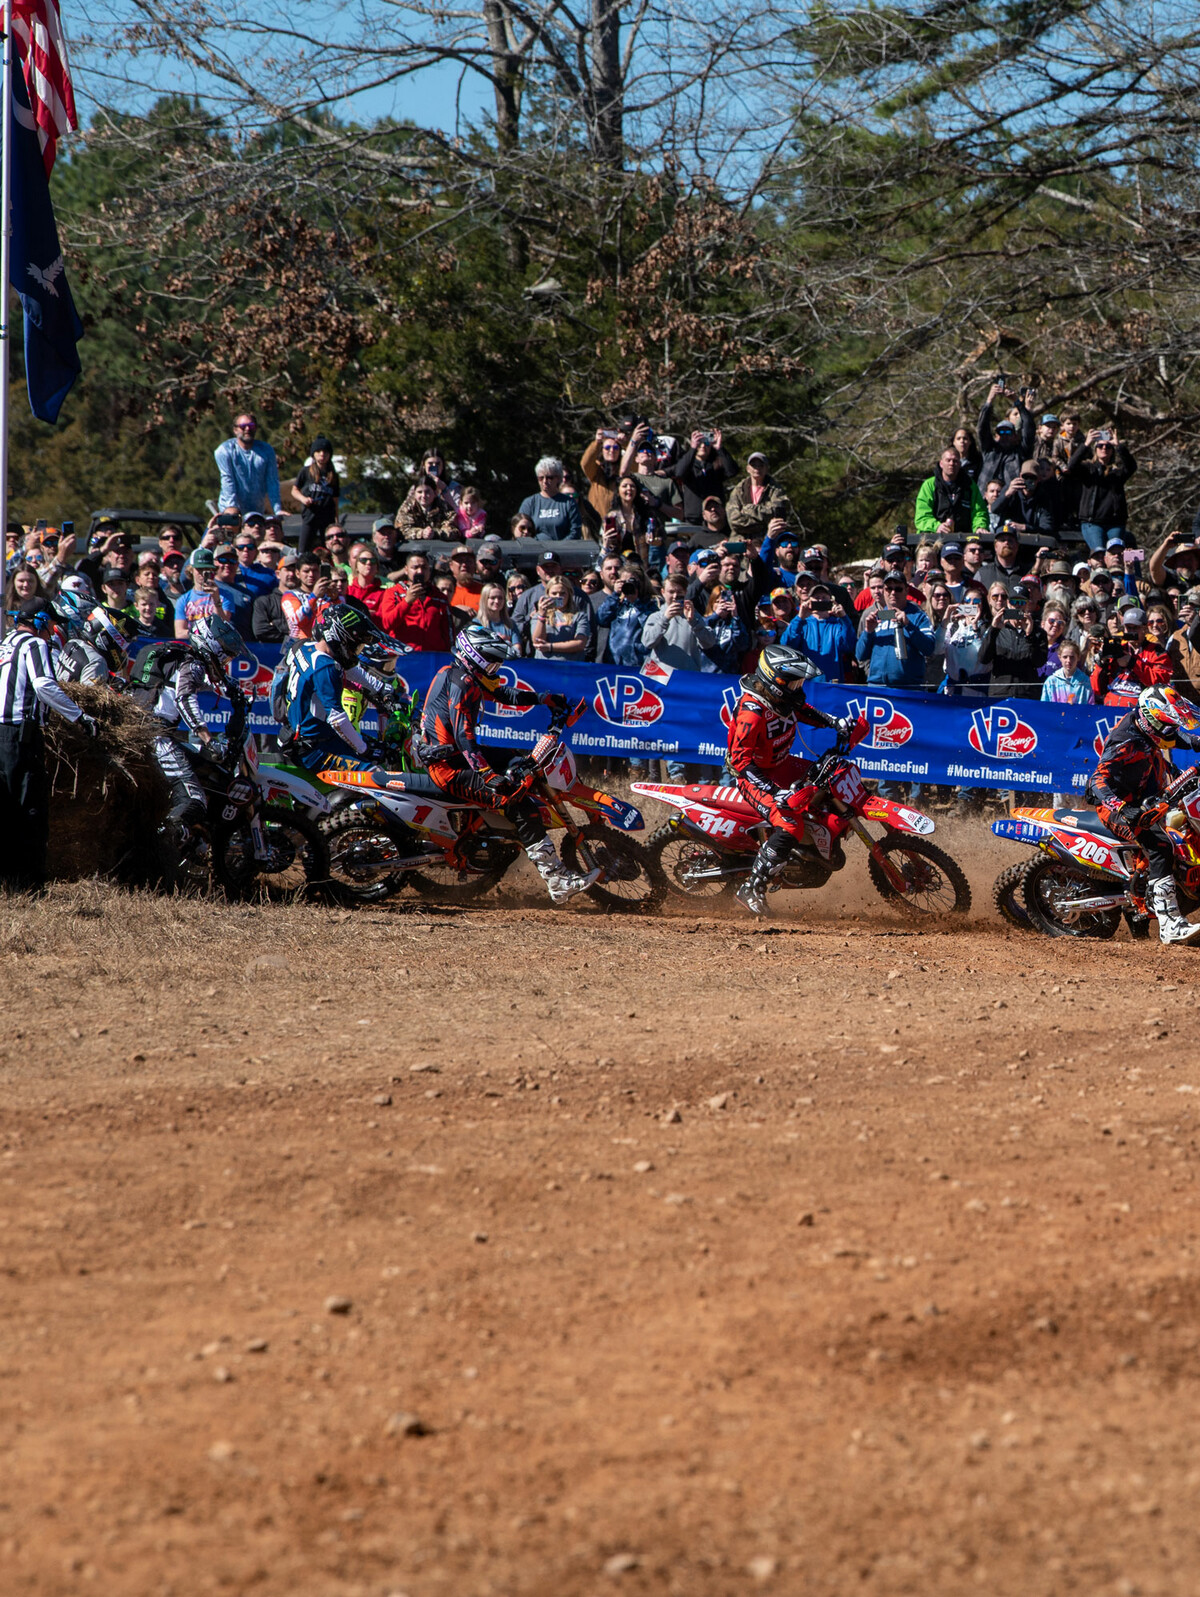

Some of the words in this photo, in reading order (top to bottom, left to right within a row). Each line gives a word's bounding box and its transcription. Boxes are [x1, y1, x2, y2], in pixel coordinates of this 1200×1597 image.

[596, 675, 644, 727] VP
[626, 702, 661, 719] Racing
[625, 719, 650, 727] FUELS
[971, 706, 1019, 759] VP
[572, 732, 679, 753] #MoreThanRaceFuel
[876, 726, 912, 742] Racing
[1000, 735, 1036, 751] Racing
[875, 741, 899, 749] FUELS
[999, 750, 1024, 759] FUELS
[849, 756, 929, 775] eThanRaceFuel
[947, 764, 1052, 785] #MoreThanRaceFuel
[836, 766, 862, 805] 314
[412, 805, 434, 825] 1
[696, 813, 738, 838] 314
[1069, 837, 1109, 865] 206
